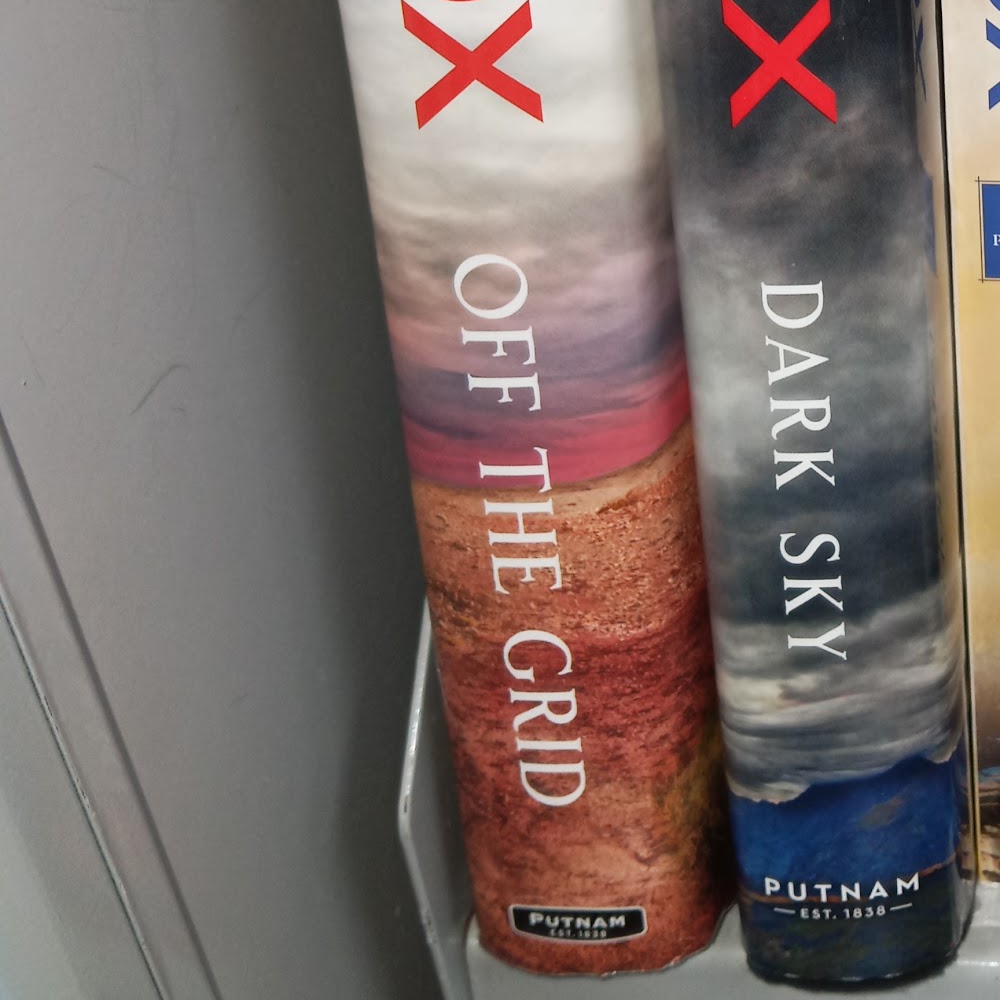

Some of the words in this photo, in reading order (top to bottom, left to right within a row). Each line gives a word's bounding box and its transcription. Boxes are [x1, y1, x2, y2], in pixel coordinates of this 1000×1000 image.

[453, 253, 542, 412] OFF
[760, 280, 836, 491] DARK
[478, 446, 563, 596] THE
[779, 531, 848, 661] SKY
[502, 629, 587, 808] GRID
[528, 911, 626, 929] PUTNAM
[764, 871, 920, 904] PUTNAM
[800, 907, 837, 920] EST.
[843, 904, 887, 920] 1838
